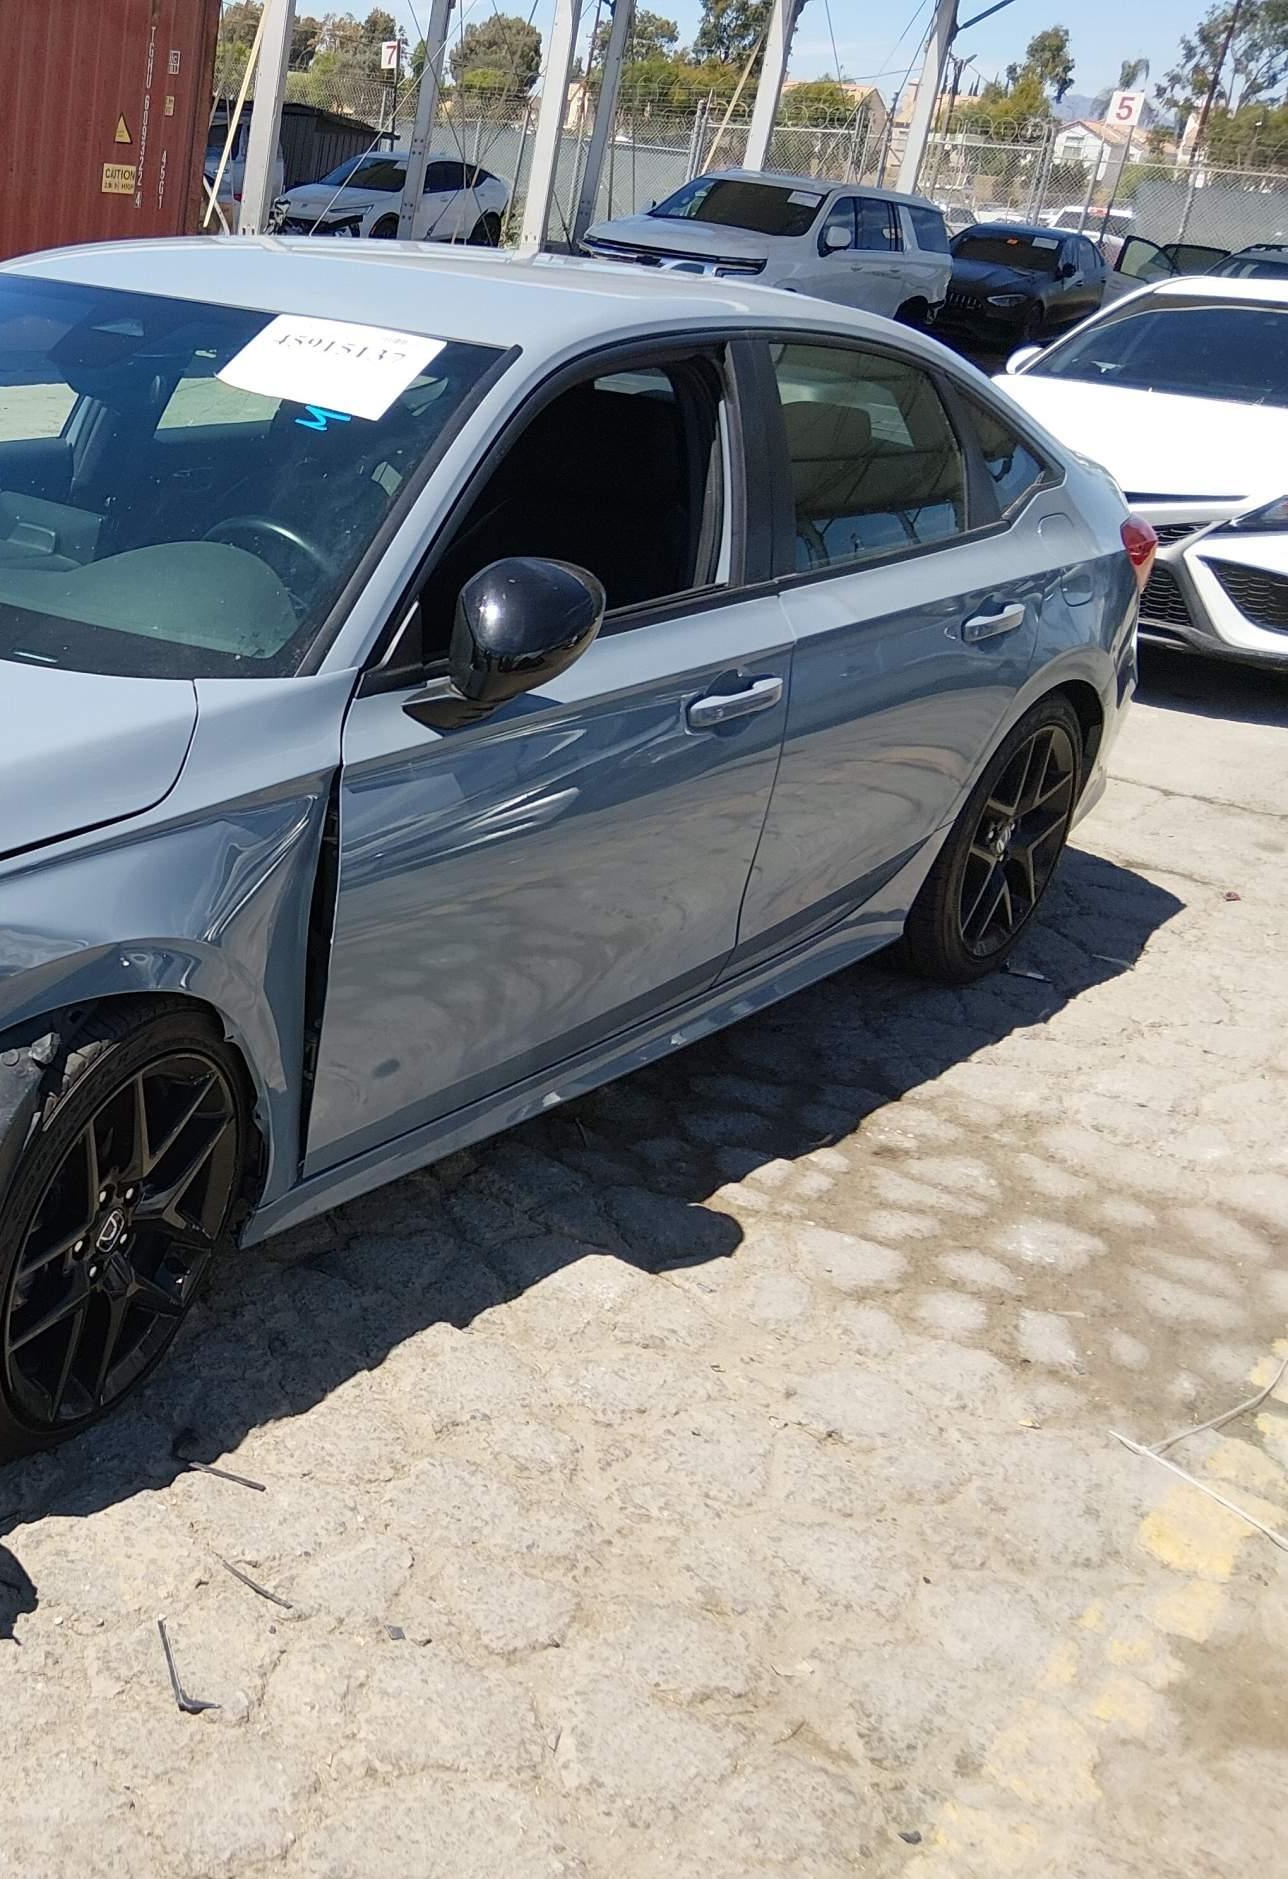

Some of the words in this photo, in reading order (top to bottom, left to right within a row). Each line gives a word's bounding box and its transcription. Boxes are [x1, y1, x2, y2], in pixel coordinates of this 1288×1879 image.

[146, 26, 157, 89] TGHU
[386, 45, 397, 65] 7
[1115, 96, 1136, 120] 5
[105, 168, 135, 181] CAUTION
